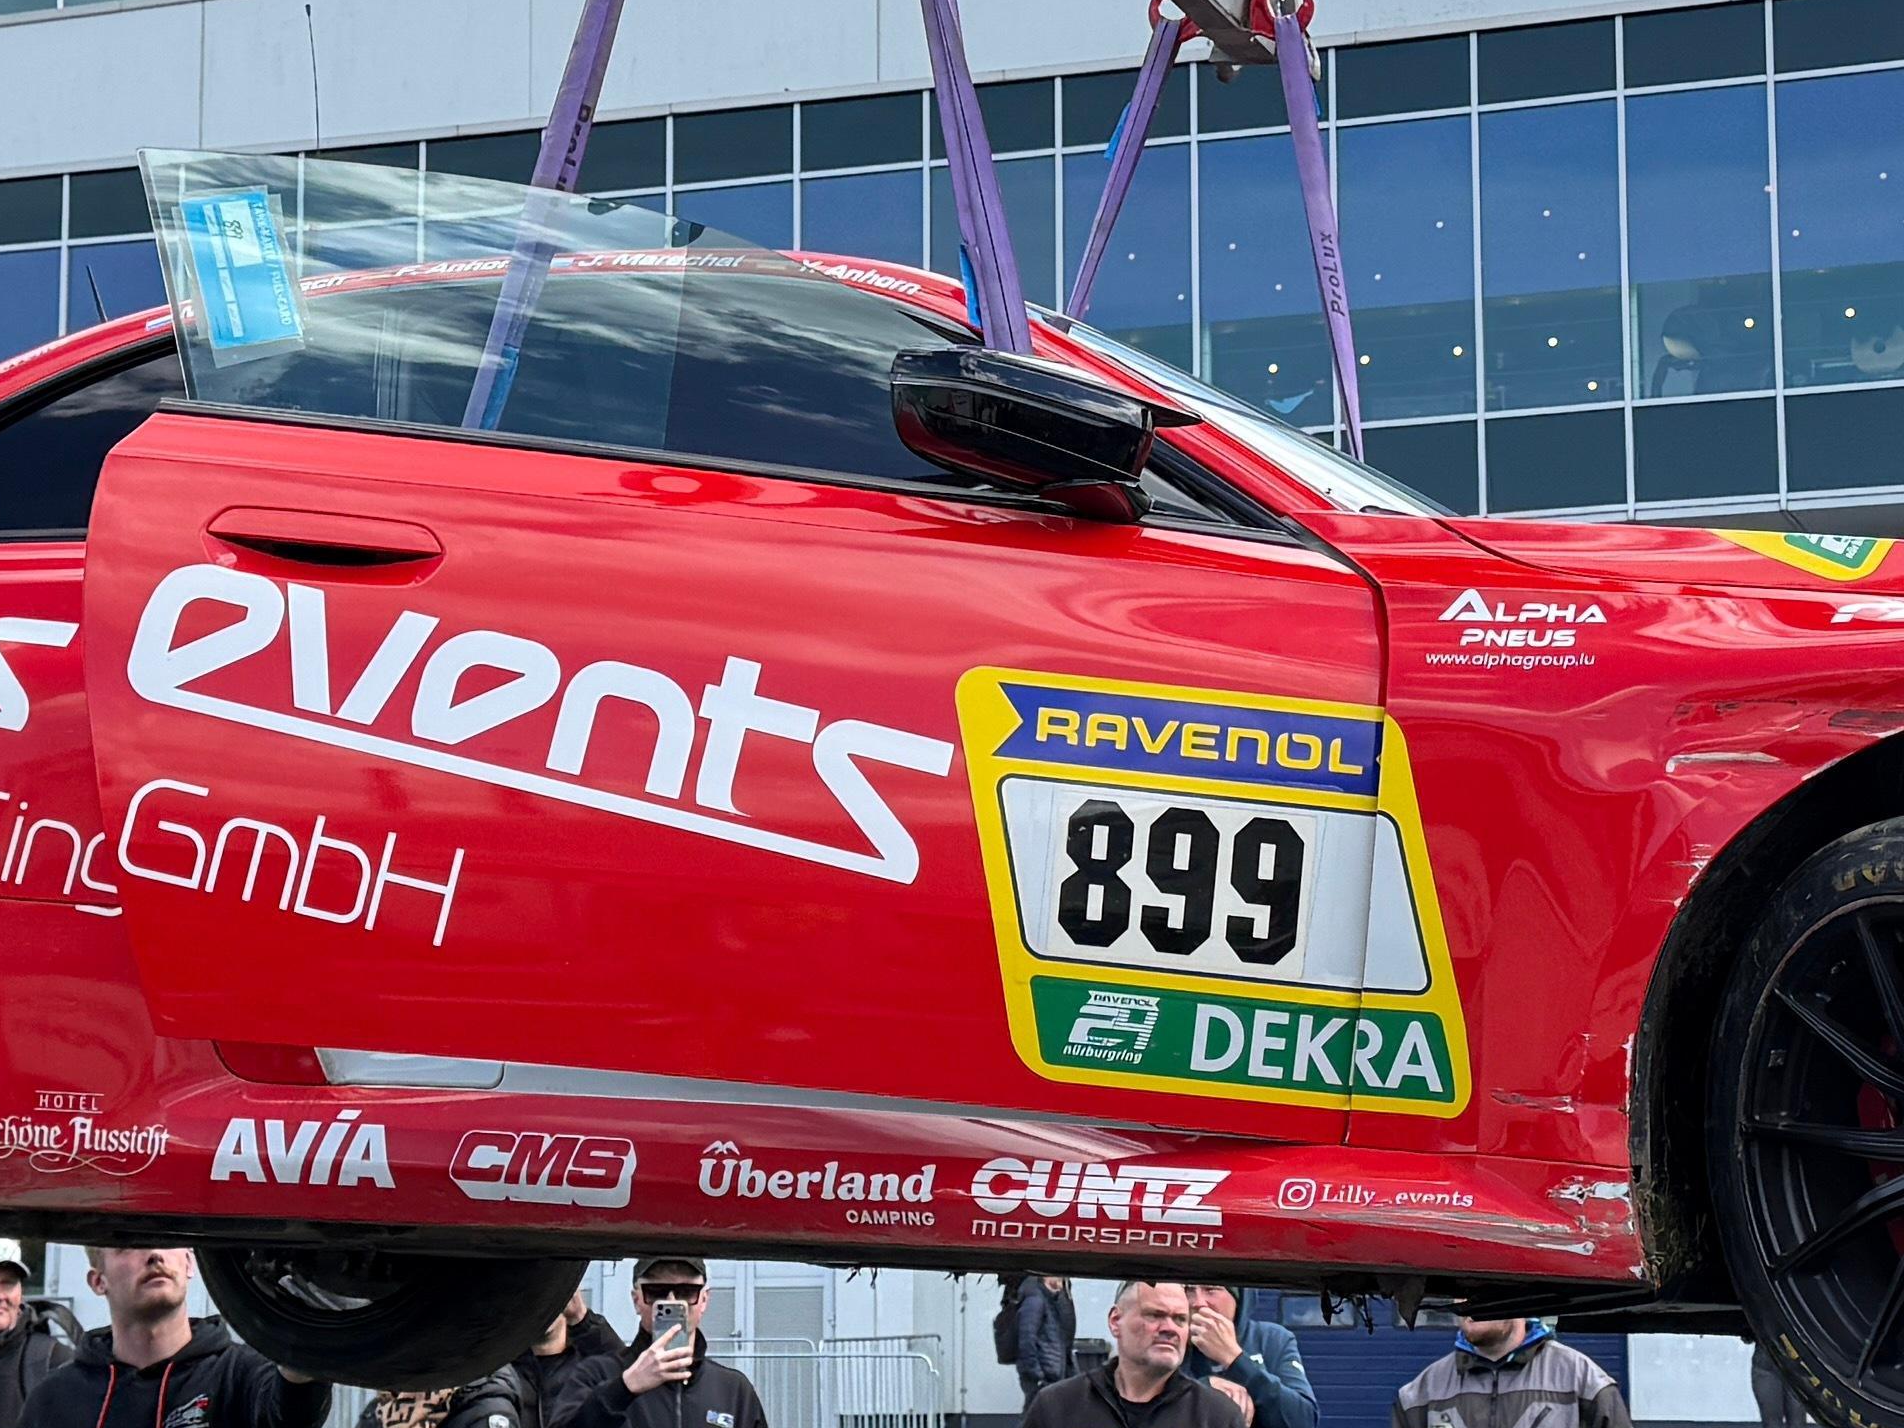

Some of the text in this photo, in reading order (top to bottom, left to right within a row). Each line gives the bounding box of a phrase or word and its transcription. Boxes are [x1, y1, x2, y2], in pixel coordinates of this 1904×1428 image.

[424, 257, 512, 275] Anhor
[825, 262, 923, 295] Anhorn
[1319, 231, 1346, 318] ProLux
[1437, 587, 1608, 625] ALPHA
[1425, 651, 1597, 671] www.alphagroup.lu
[1459, 628, 1577, 648] PNEUS
[126, 562, 954, 886] events
[1035, 705, 1365, 776] RAVENOL
[116, 778, 466, 948] GmbH
[1057, 798, 1306, 966] 899
[1190, 1002, 1445, 1093] DEKRA
[38, 1093, 100, 1113] HOTEL
[450, 1128, 638, 1210] CMS
[971, 1157, 1232, 1226] CUNTZ
[845, 1209, 936, 1228] CAMPING
[971, 1218, 1225, 1251] MOTORSPORT
